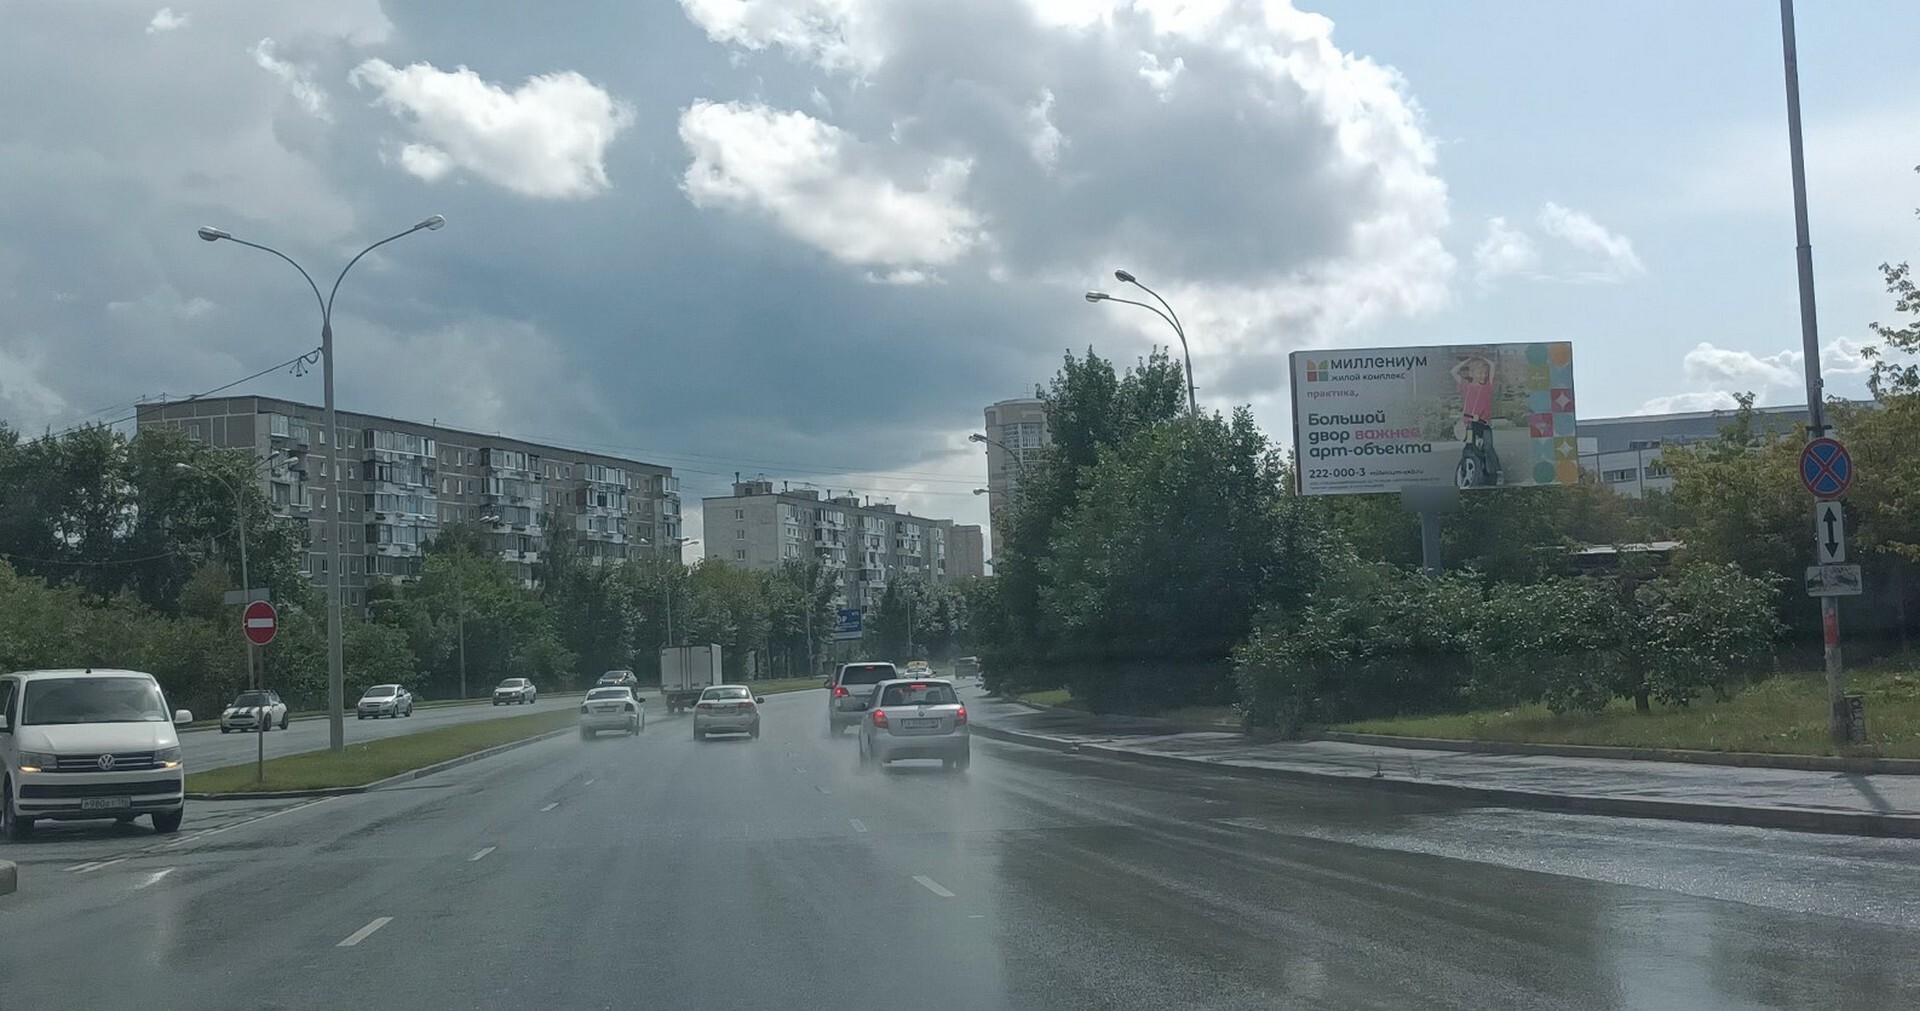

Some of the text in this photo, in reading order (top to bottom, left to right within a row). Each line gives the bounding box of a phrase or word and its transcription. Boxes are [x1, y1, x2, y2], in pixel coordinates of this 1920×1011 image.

[1331, 355, 1427, 370] миллениум
[1331, 372, 1406, 382] жилой комплекс
[1307, 390, 1359, 400] практика,
[1308, 410, 1386, 426] Большой
[1308, 427, 1420, 444] двор важнее
[1310, 442, 1432, 460] арт-объекта
[1309, 468, 1366, 478] 222-000-3
